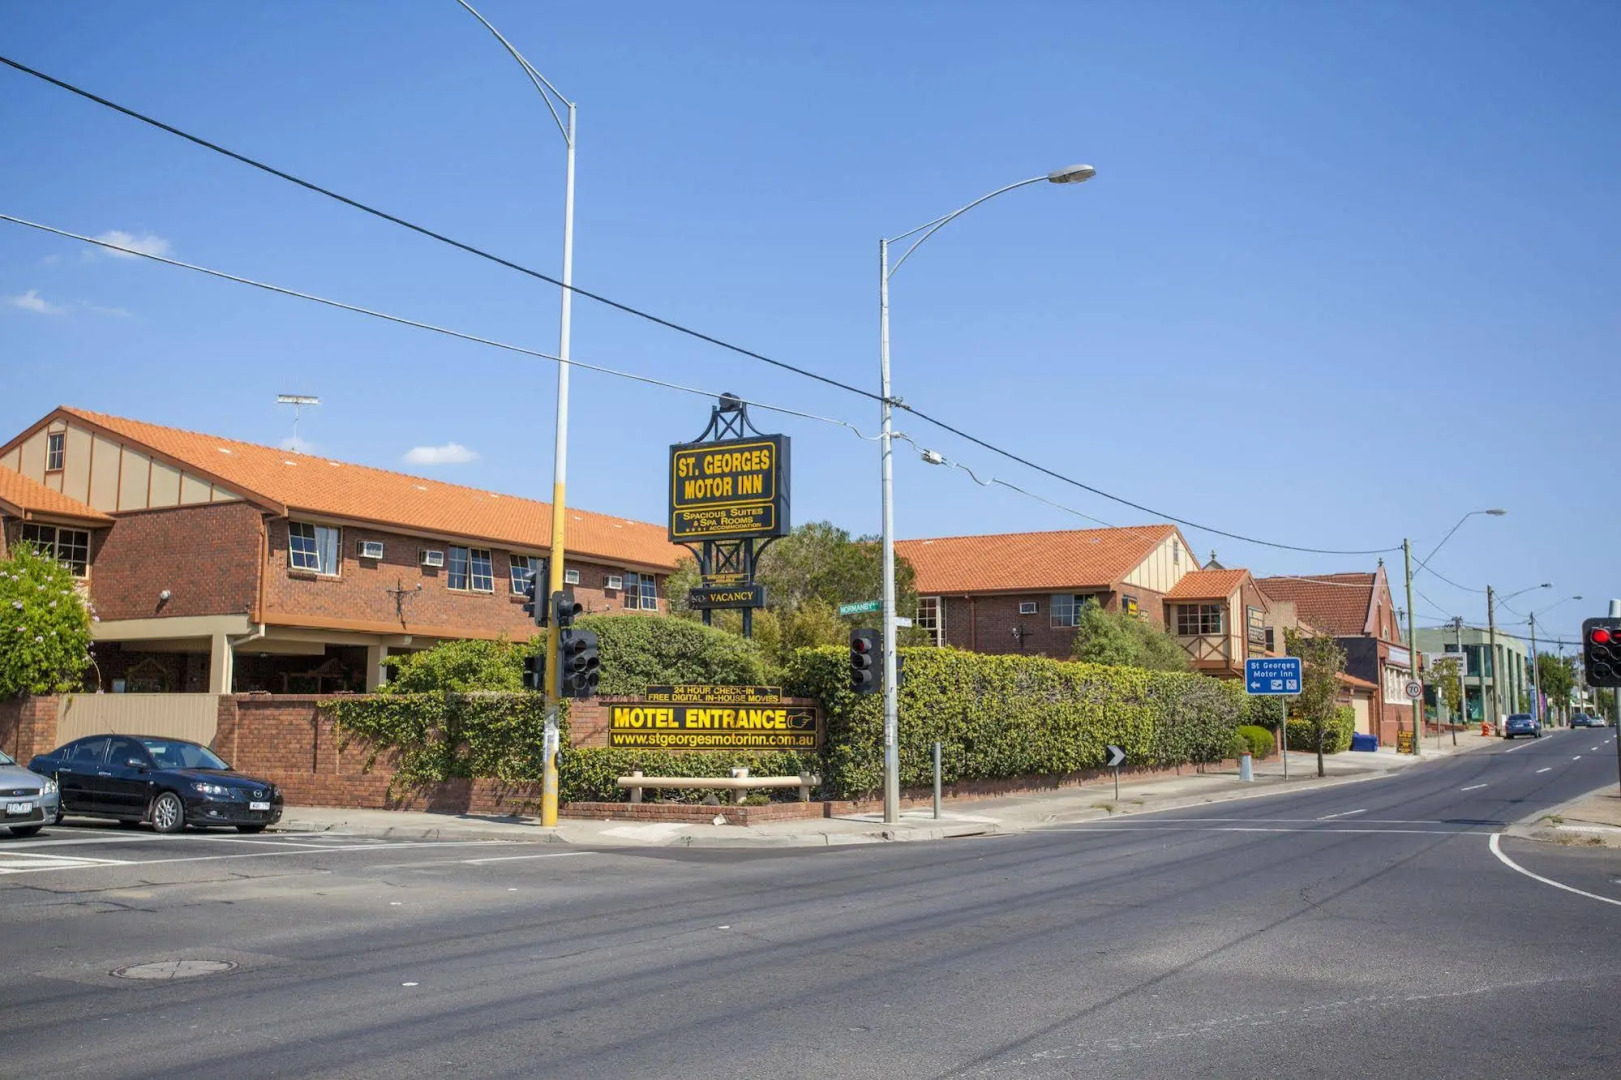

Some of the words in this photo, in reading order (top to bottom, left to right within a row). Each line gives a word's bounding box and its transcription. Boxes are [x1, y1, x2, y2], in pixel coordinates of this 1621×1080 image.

[678, 457, 699, 477] ST.
[704, 449, 770, 475] GEORGES
[684, 477, 732, 500] MOTOR
[738, 474, 763, 495] INN
[709, 522, 761, 531] ACCOMMODATION
[710, 591, 754, 602] VACANCY
[840, 602, 872, 614] NORMANBY
[1263, 662, 1295, 670] Georges
[1253, 670, 1277, 678] Motor
[1408, 686, 1419, 694] 70
[648, 693, 669, 701] FREE
[705, 694, 746, 702] IN-HOUSE
[748, 695, 779, 703] MOVIES
[614, 707, 679, 728] MOTEL
[685, 708, 787, 729] ENTRANCE
[613, 732, 813, 747] www.stgeorgesmotorinn.com.au
